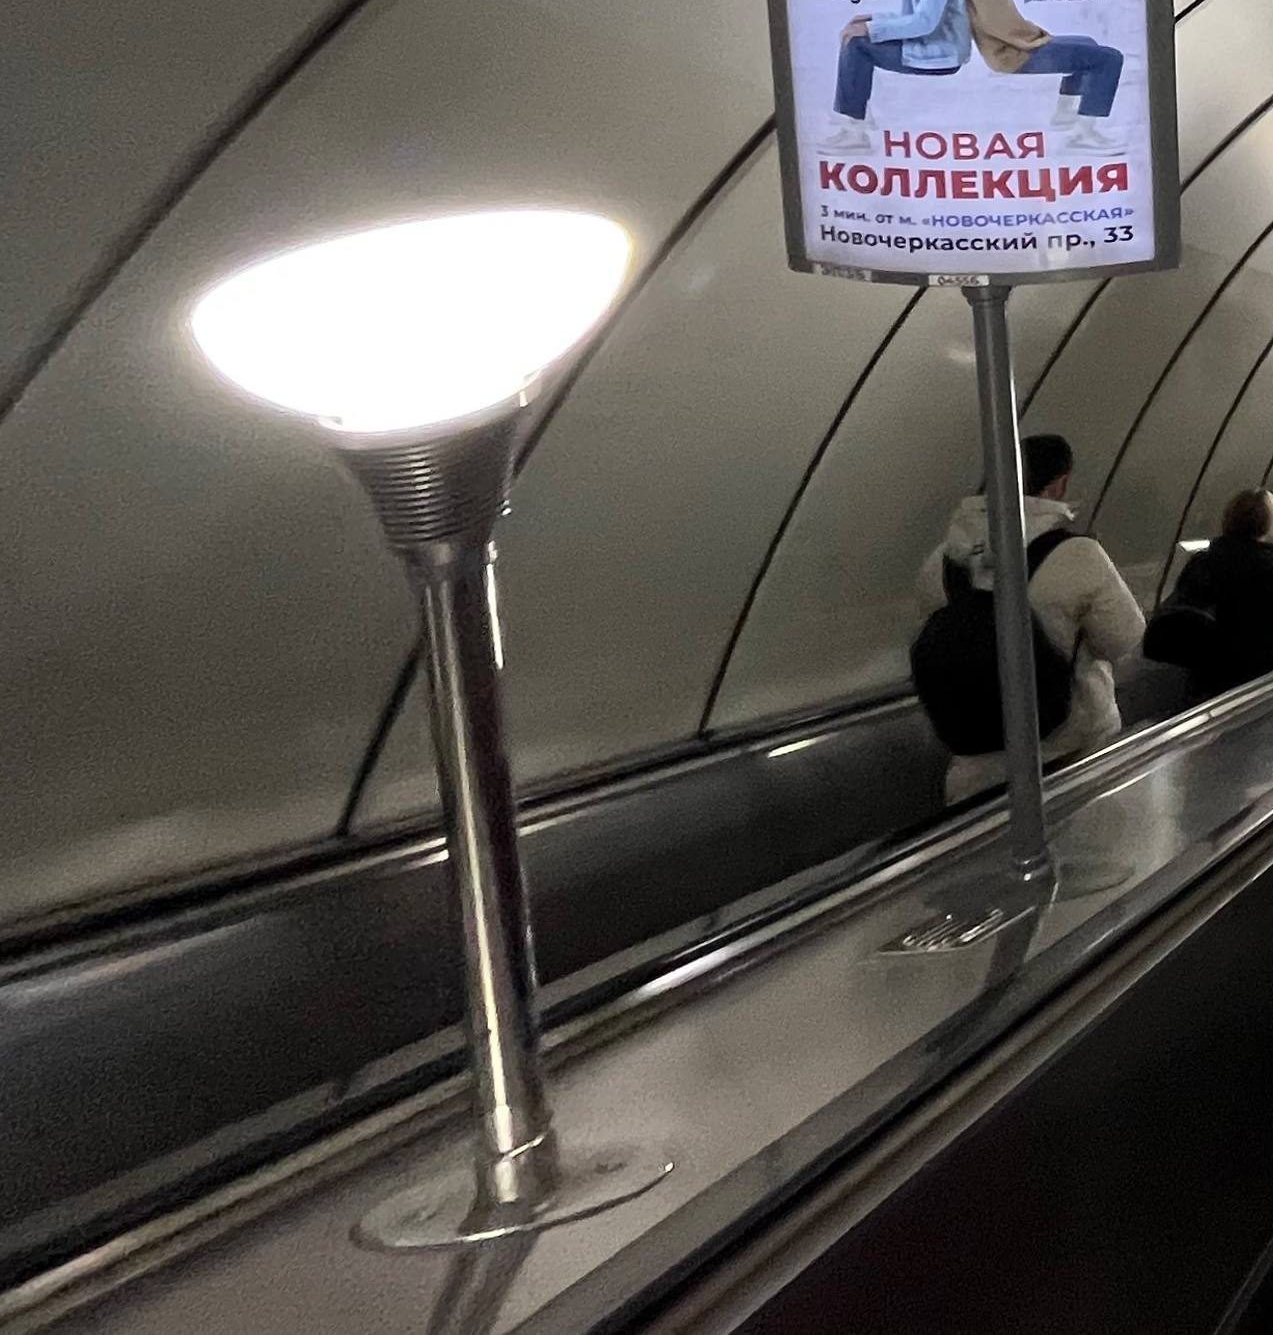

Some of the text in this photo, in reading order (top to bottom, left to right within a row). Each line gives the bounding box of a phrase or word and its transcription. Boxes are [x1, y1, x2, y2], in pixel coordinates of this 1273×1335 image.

[883, 130, 1045, 161] НОВАЯ
[819, 161, 1129, 203] КОЛЛЕКЦИЯ
[821, 205, 829, 217] 3
[833, 210, 867, 224] мин.
[875, 214, 894, 225] от
[922, 206, 1135, 228] «НОВОЧЕРКАССКАЯ»
[821, 224, 1134, 253] Новочеркасский пр., 33
